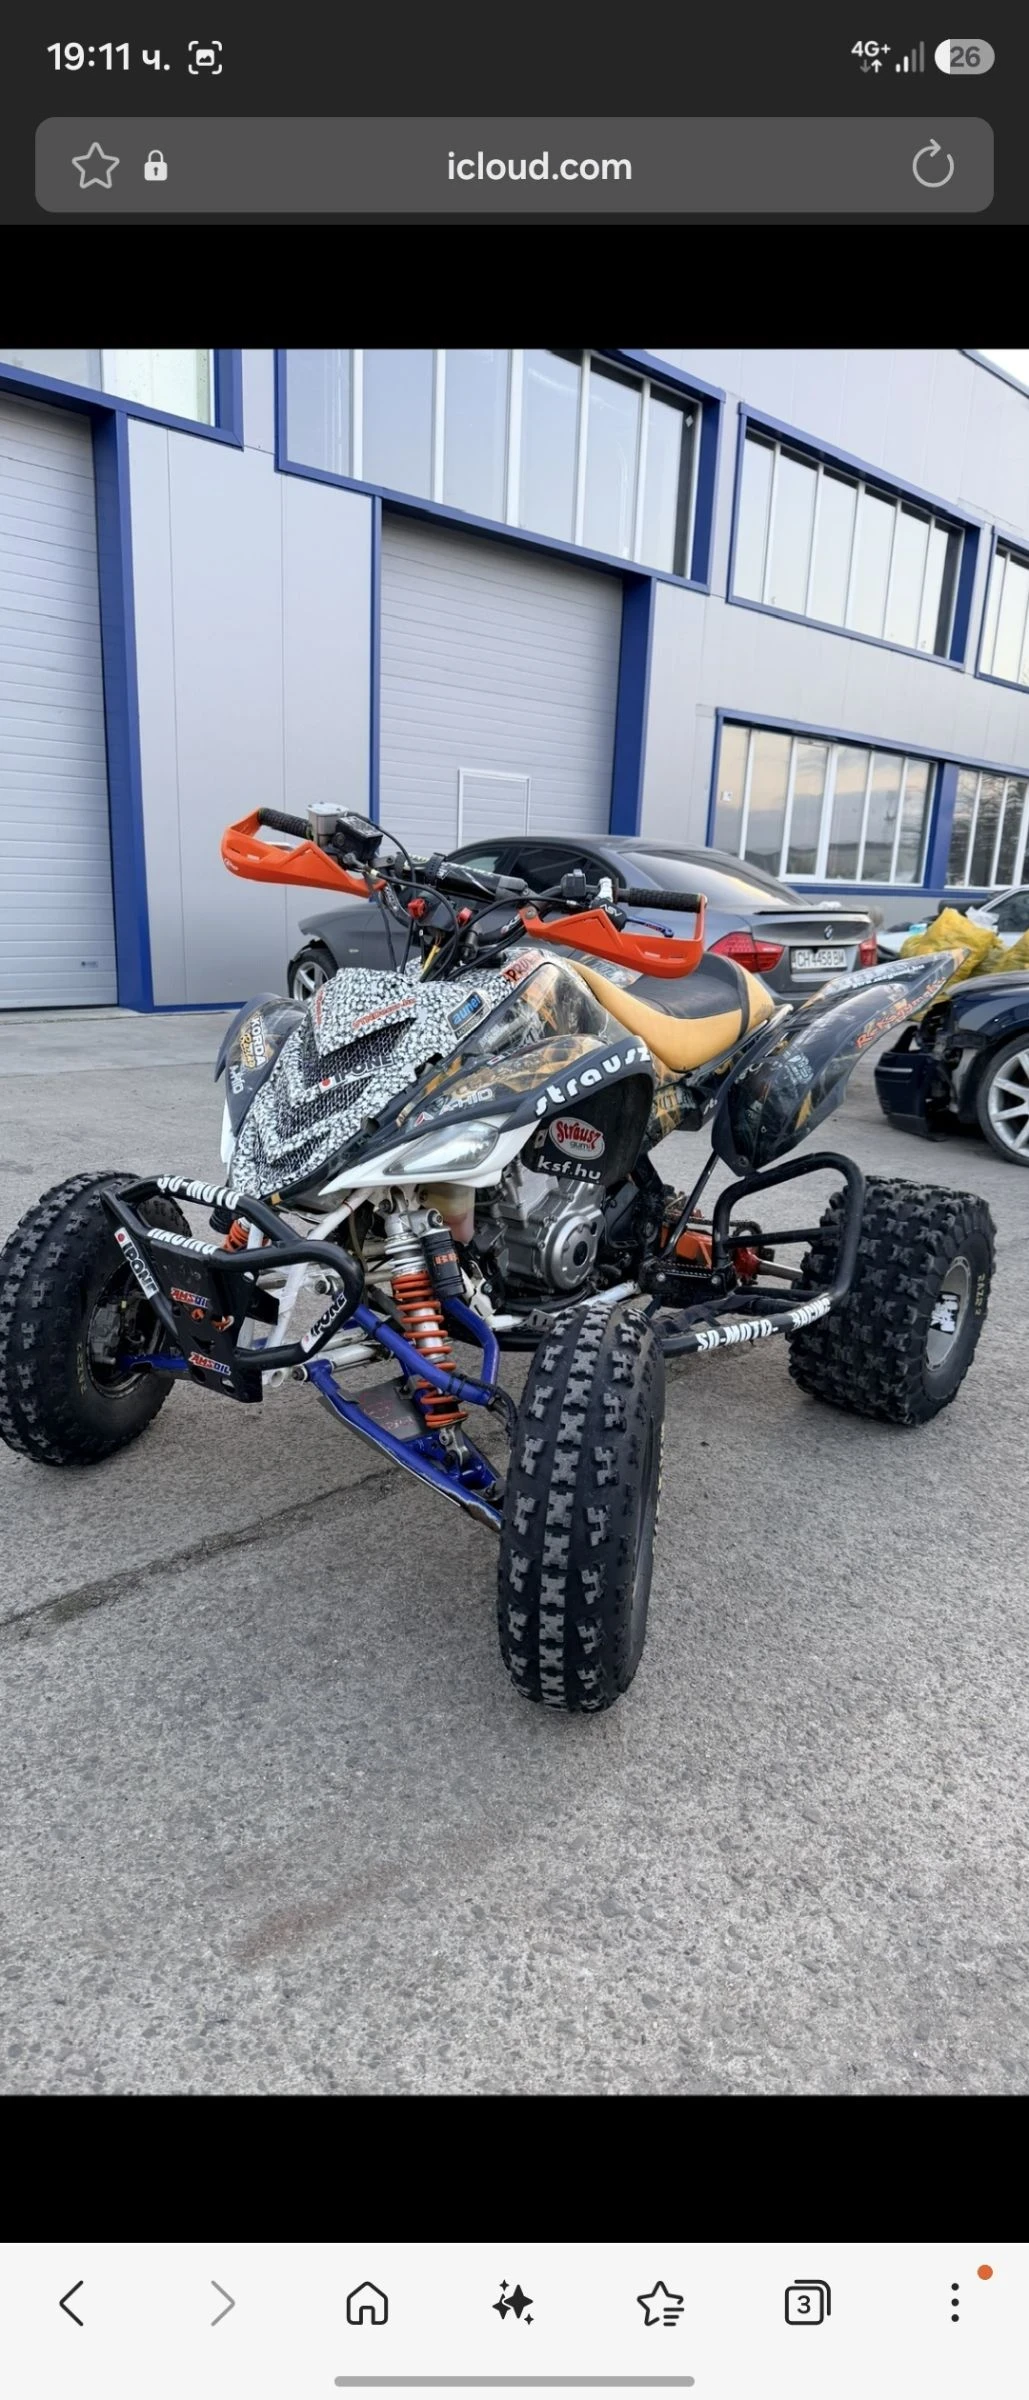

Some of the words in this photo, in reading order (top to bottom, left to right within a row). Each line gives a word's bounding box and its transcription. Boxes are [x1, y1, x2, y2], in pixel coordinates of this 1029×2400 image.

[251, 1017, 266, 1066] KORDA
[334, 1054, 394, 1082] IPONE
[534, 1047, 651, 1116] strausz
[538, 1155, 601, 1181] ksf.hu
